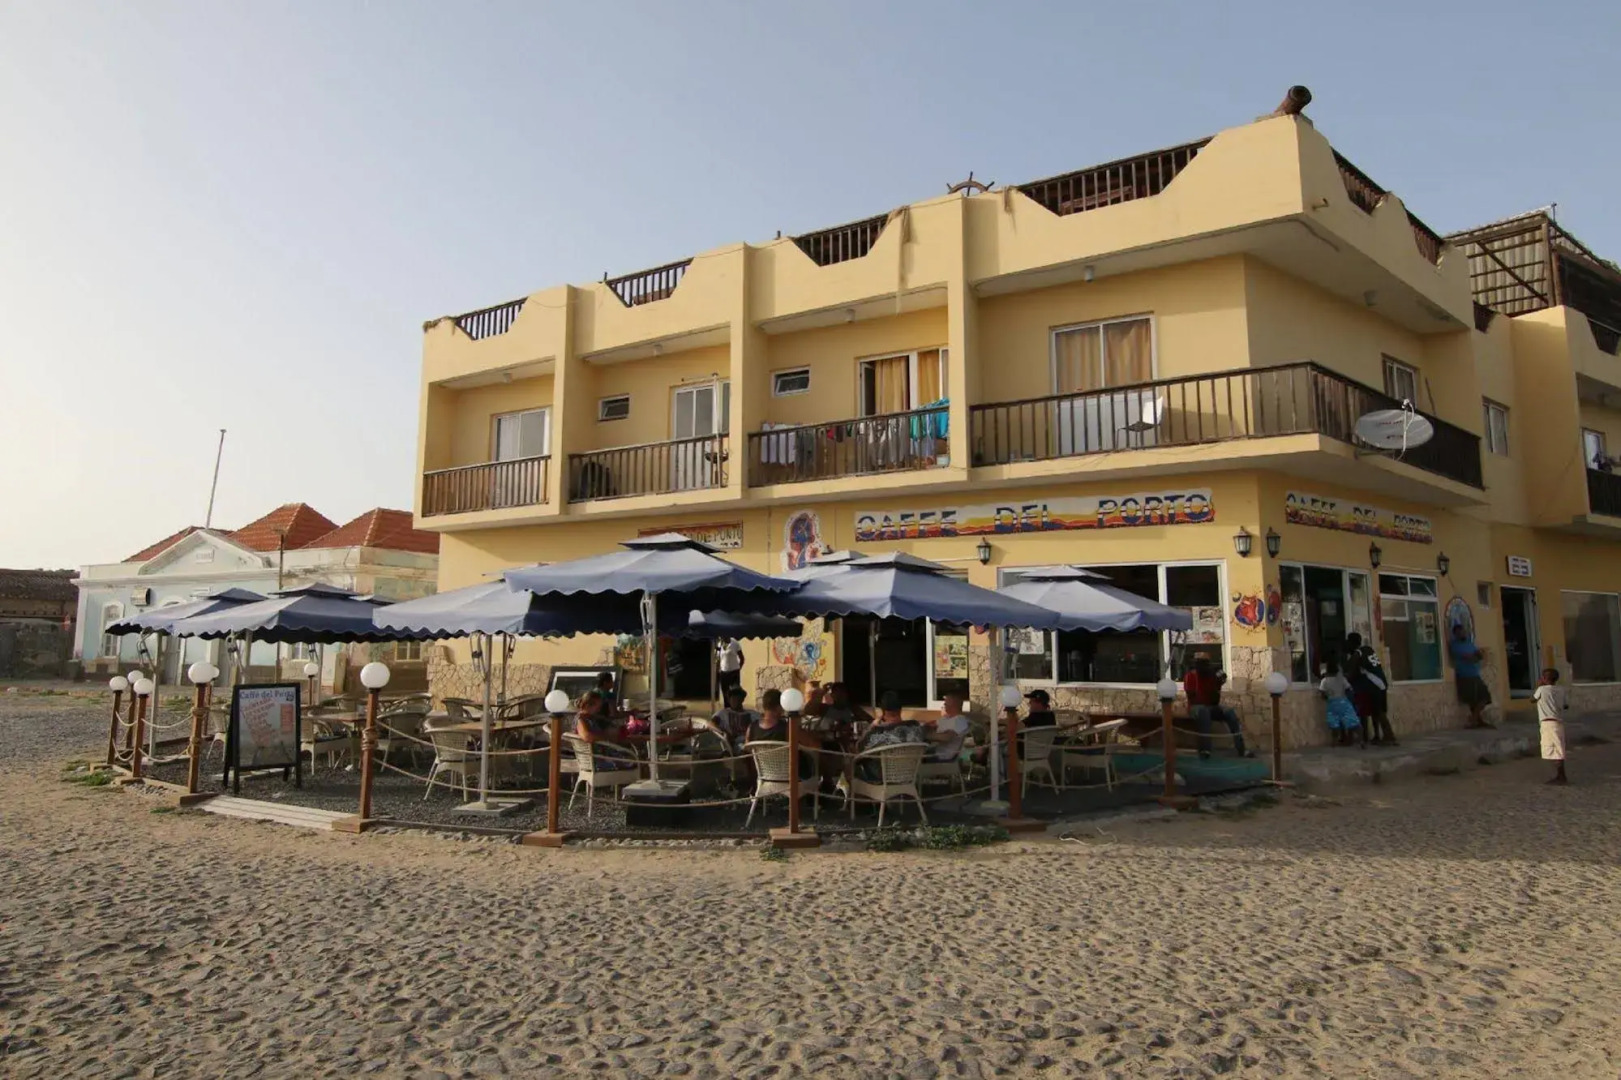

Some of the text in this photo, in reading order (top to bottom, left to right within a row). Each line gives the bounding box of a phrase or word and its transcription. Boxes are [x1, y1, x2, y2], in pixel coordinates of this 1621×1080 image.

[857, 494, 1209, 540] CAFFE DEL PORTO
